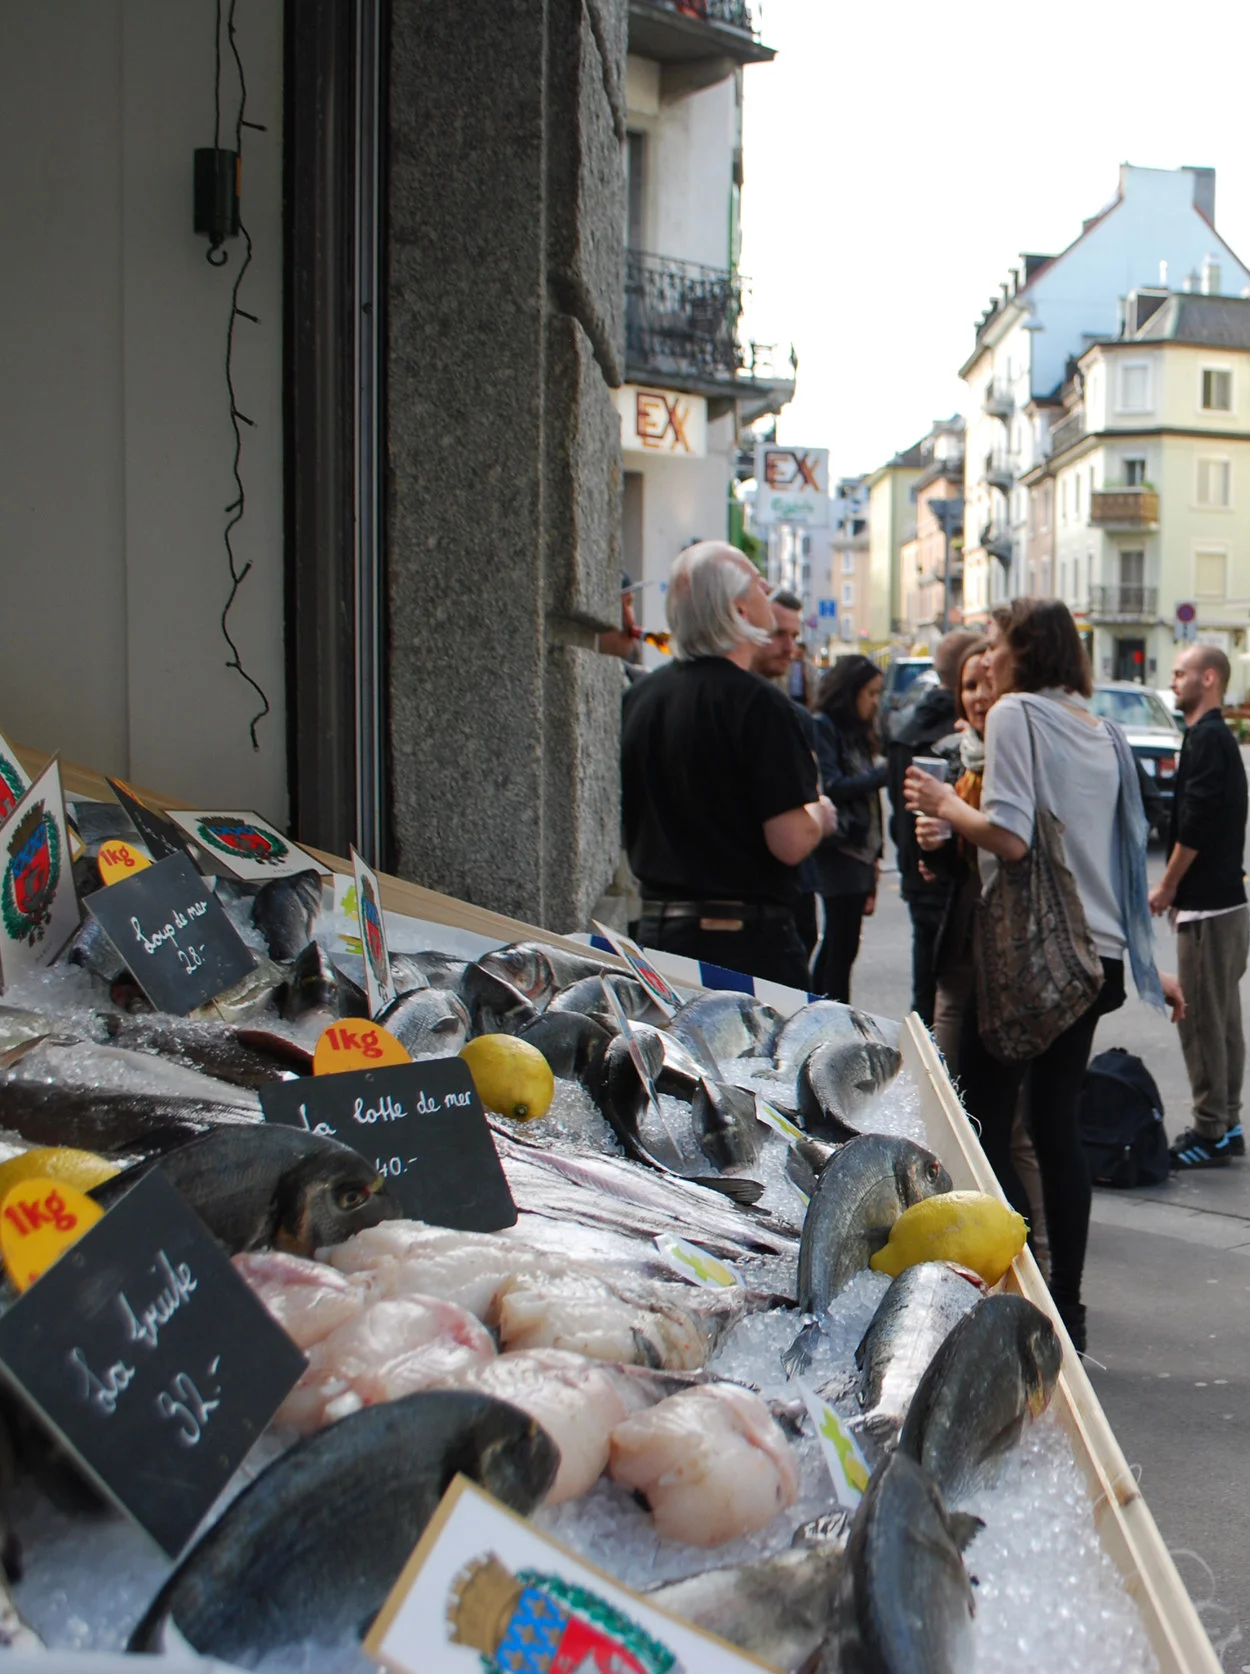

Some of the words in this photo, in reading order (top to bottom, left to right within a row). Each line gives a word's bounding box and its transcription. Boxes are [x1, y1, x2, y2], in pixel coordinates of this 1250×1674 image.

[636, 391, 691, 452] EX
[764, 451, 820, 492] EX
[101, 845, 136, 868] 1kg
[130, 916, 179, 954] Loup
[172, 909, 188, 928] de
[187, 901, 208, 920] mer
[325, 1028, 384, 1059] 1kg
[299, 1104, 337, 1136] La
[353, 1097, 408, 1125] lotte
[416, 1090, 441, 1114] de
[443, 1090, 472, 1108] mer
[4, 1188, 78, 1237] 1kg
[70, 1347, 136, 1415] La
